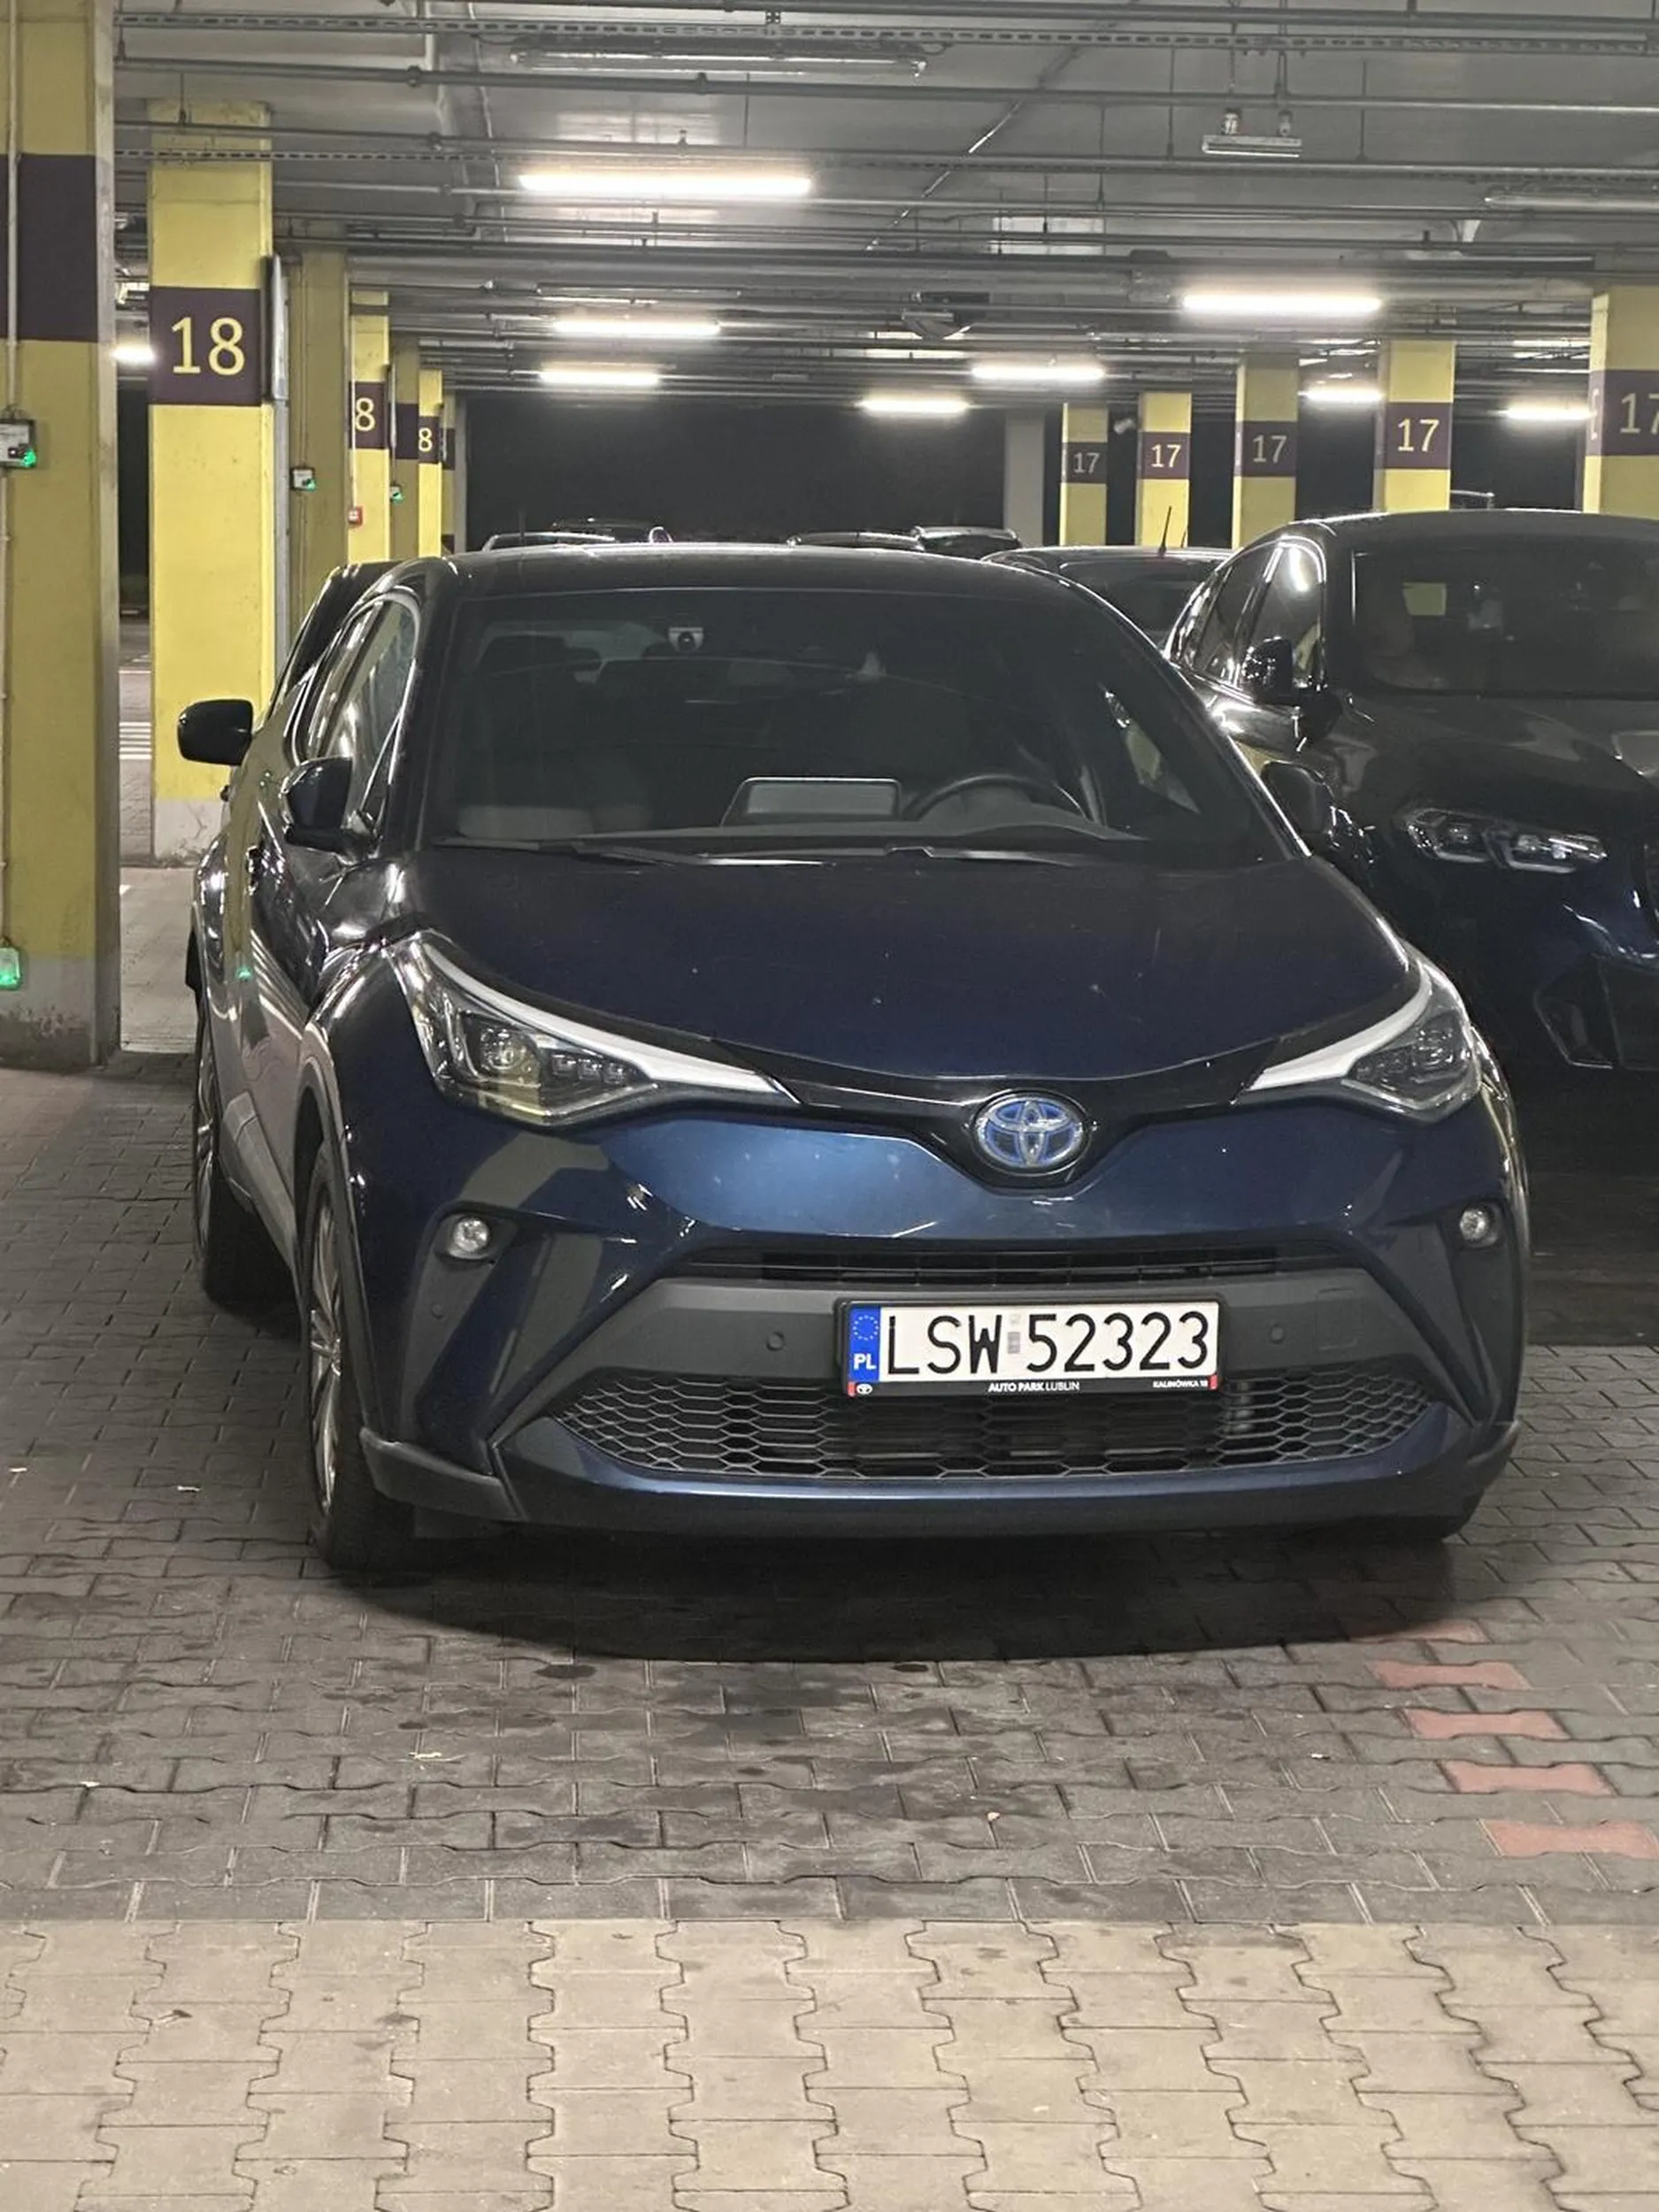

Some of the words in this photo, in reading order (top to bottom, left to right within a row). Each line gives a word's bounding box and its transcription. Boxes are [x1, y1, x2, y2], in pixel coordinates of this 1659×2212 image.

[172, 317, 245, 375] 18
[355, 397, 375, 431] 8
[419, 427, 432, 452] 8
[1398, 418, 1440, 452] 17
[1151, 444, 1181, 467] 17
[1253, 434, 1286, 464] 17
[1073, 452, 1100, 474] 17
[888, 1315, 1002, 1375] LSW
[1026, 1311, 1209, 1372] 52323
[853, 1353, 877, 1371] PL
[988, 1382, 1017, 1393] AUTO
[1018, 1381, 1044, 1392] PARK
[1045, 1380, 1080, 1392] LUBLIN
